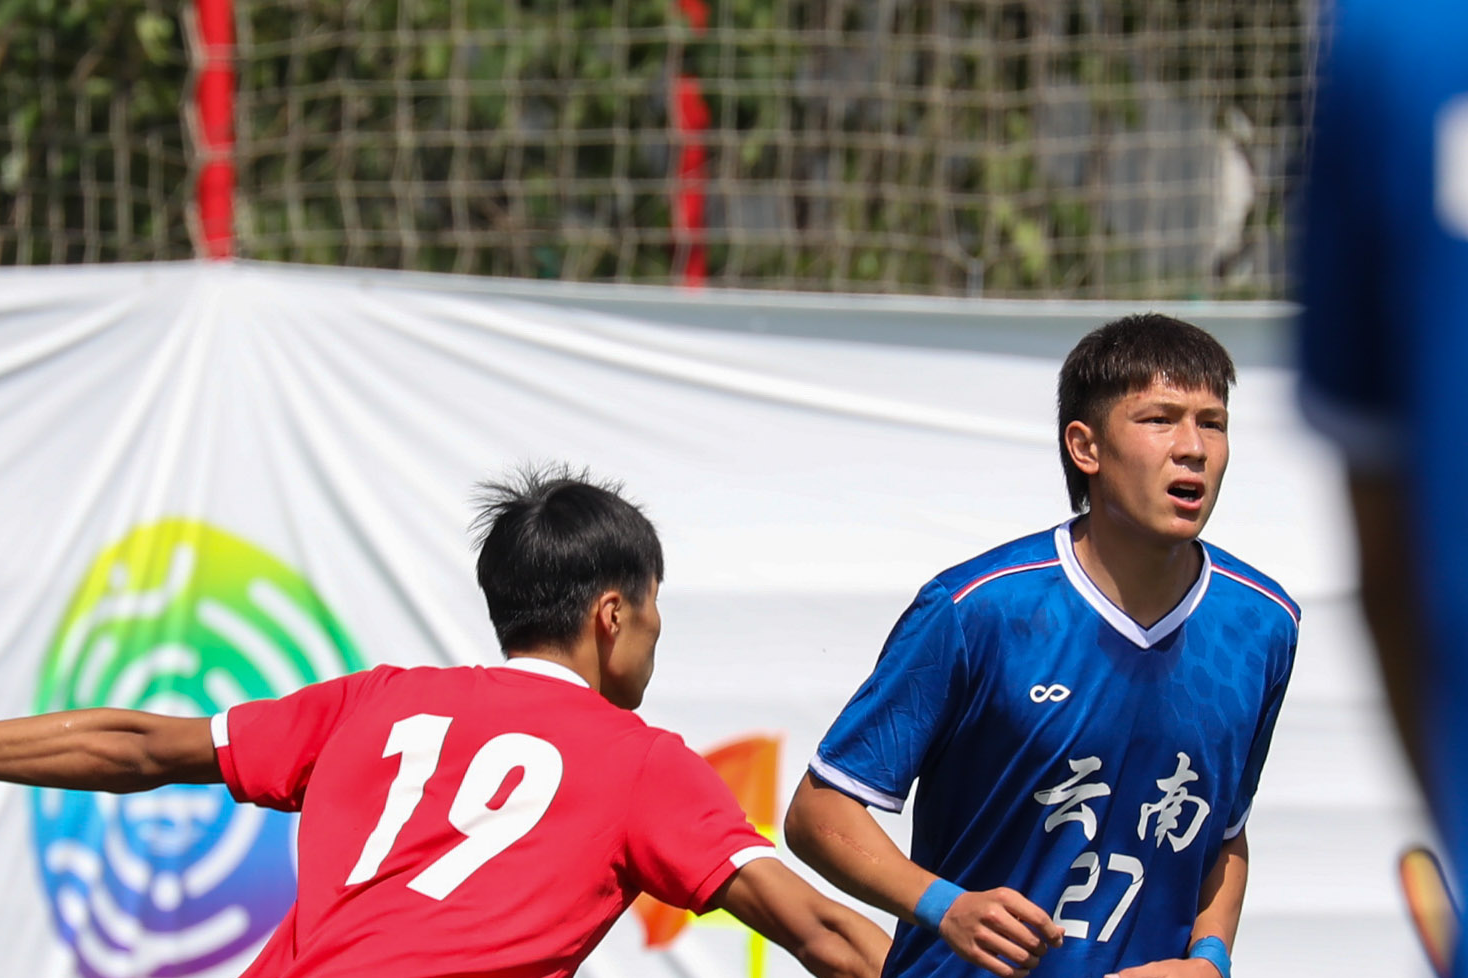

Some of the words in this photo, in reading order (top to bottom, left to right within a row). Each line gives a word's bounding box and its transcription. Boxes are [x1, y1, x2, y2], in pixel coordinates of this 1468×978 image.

[344, 712, 564, 901] 19
[1033, 751, 1211, 853] 云南
[1052, 851, 1145, 943] 27
